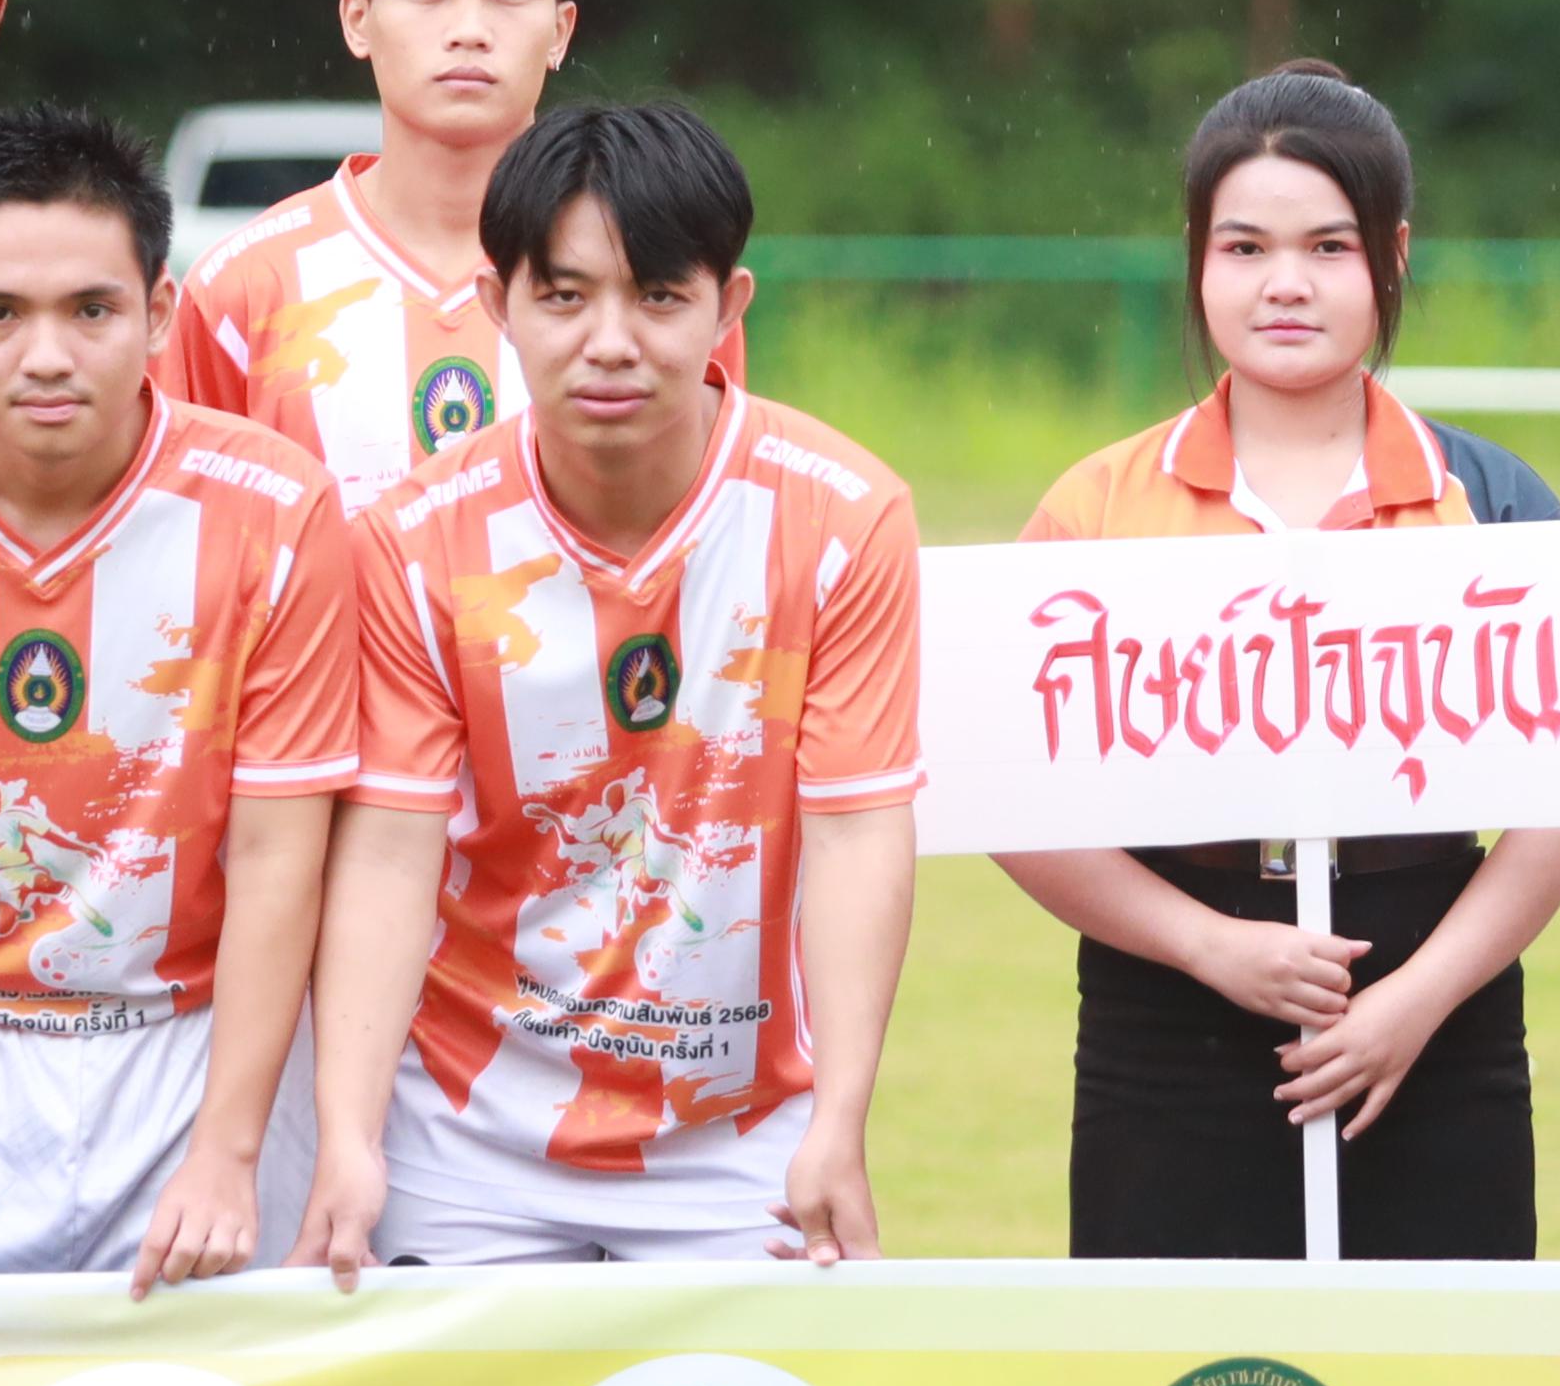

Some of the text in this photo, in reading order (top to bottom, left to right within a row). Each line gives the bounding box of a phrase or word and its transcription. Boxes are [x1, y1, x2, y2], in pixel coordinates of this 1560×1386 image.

[179, 448, 305, 508] COMTMS
[134, 1009, 146, 1027] 1
[720, 1041, 730, 1057] 1
